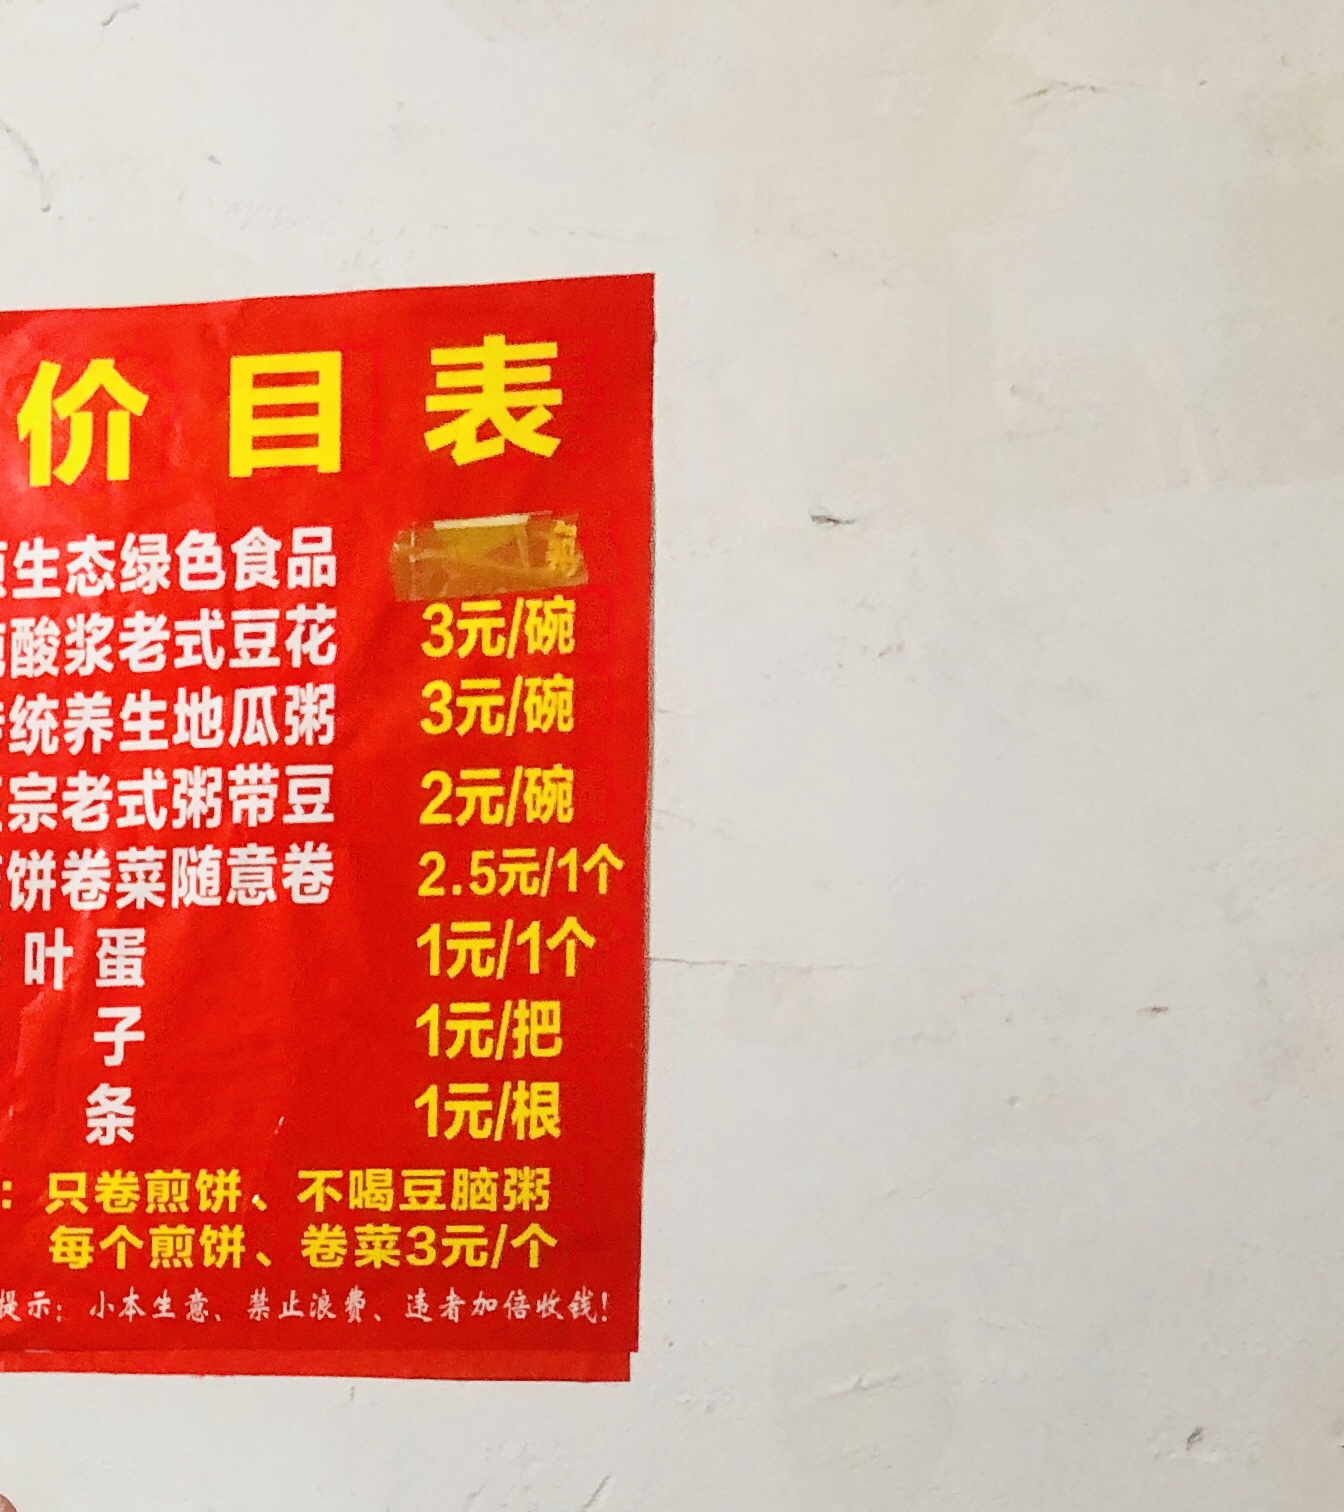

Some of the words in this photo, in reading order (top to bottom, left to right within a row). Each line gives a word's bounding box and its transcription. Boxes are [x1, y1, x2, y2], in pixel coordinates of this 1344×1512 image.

[17, 334, 563, 487] 价目表
[421, 594, 576, 660] 3元/碗
[420, 673, 574, 737] 3元/碗
[419, 764, 575, 827] 2元/碗
[417, 844, 624, 898] 2.5元/1个
[416, 917, 596, 980] 1元/1个
[416, 999, 563, 1061] 1元/把
[414, 1080, 561, 1142] 1元/根
